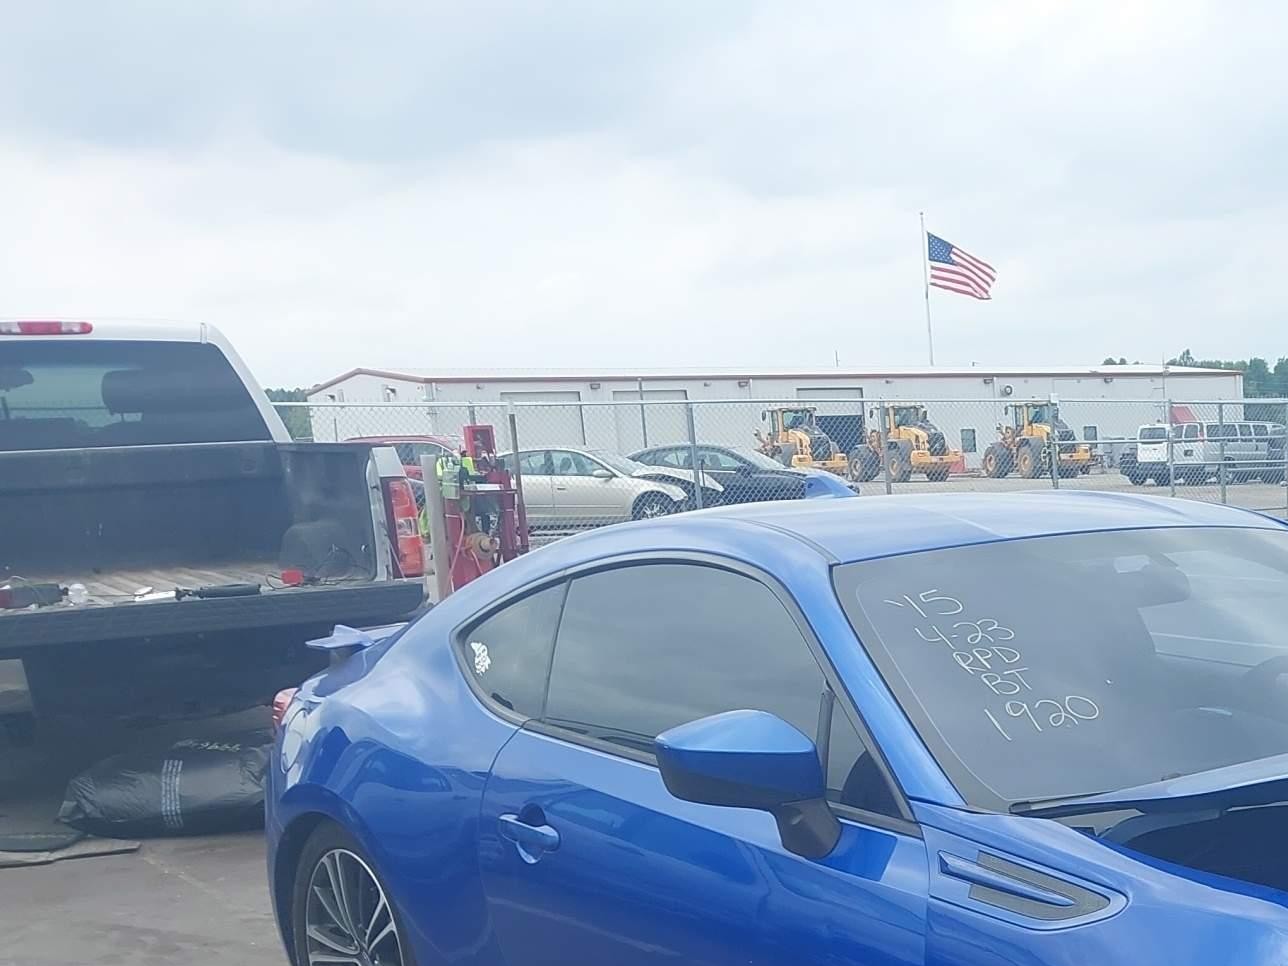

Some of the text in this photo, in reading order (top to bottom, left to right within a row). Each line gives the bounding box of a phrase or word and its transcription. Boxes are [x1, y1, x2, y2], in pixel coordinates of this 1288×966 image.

[952, 646, 1021, 674] RPD
[980, 667, 1032, 695] BT
[984, 695, 1099, 742] 1920
